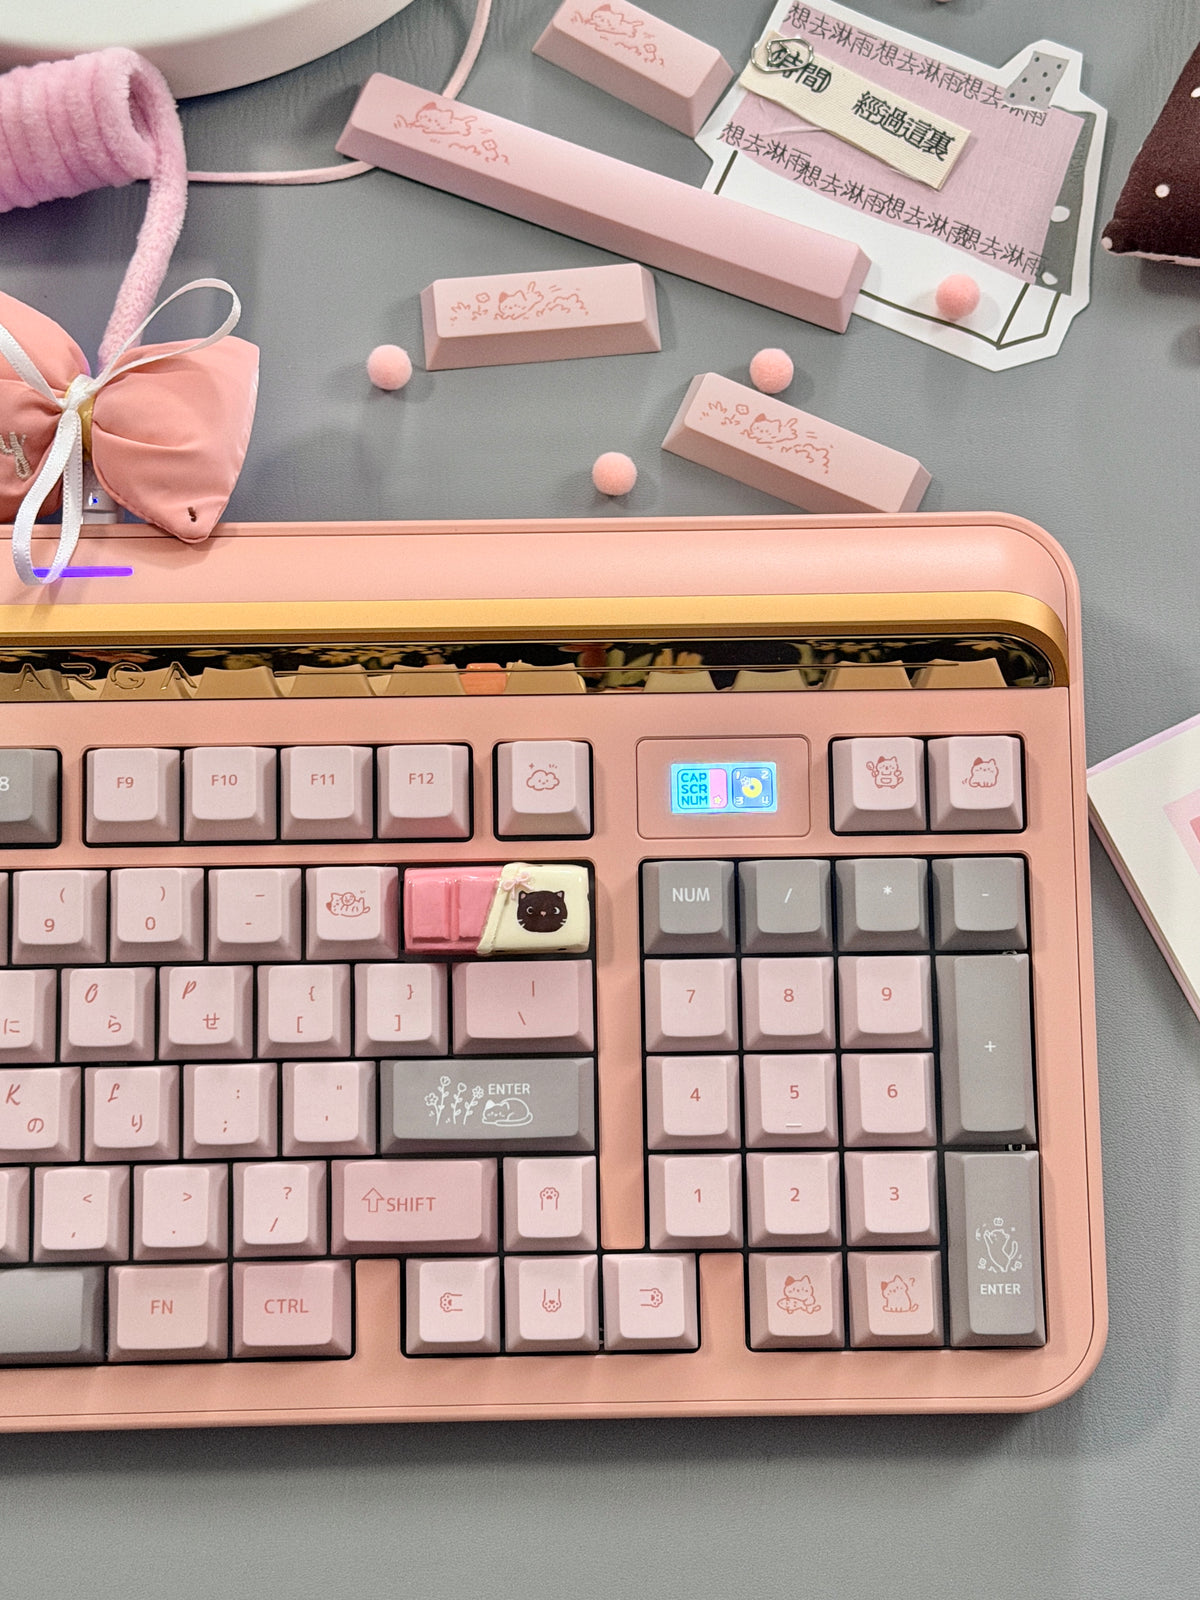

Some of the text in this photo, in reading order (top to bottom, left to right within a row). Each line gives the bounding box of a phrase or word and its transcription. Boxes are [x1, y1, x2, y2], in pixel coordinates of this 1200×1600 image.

[116, 776, 134, 789] F9
[211, 774, 238, 787] F10
[310, 773, 335, 786] F11
[408, 772, 434, 785] F12
[681, 772, 707, 783] CAP
[681, 784, 708, 794] SCR
[681, 795, 708, 805] NUM
[672, 887, 711, 903] NUM
[44, 918, 55, 933] 9
[144, 916, 156, 931] 0
[686, 989, 696, 1004] 7
[783, 988, 795, 1003] 8
[881, 986, 893, 1002] 9
[3, 1018, 21, 1035] に
[107, 1014, 122, 1033] ら
[202, 1012, 221, 1030] せ
[5, 1083, 21, 1106] K
[488, 1083, 531, 1096] ENTER
[689, 1087, 701, 1102] 4
[789, 1084, 800, 1100] 5
[887, 1083, 898, 1099] 6
[27, 1117, 45, 1134] の
[131, 1114, 143, 1134] り
[694, 1188, 702, 1203] 1
[790, 1187, 800, 1202] 2
[889, 1186, 900, 1201] 3
[386, 1196, 437, 1213] SHIFT
[980, 1283, 1021, 1295] ENTER
[150, 1299, 174, 1315] FN
[264, 1298, 309, 1314] CTRL
